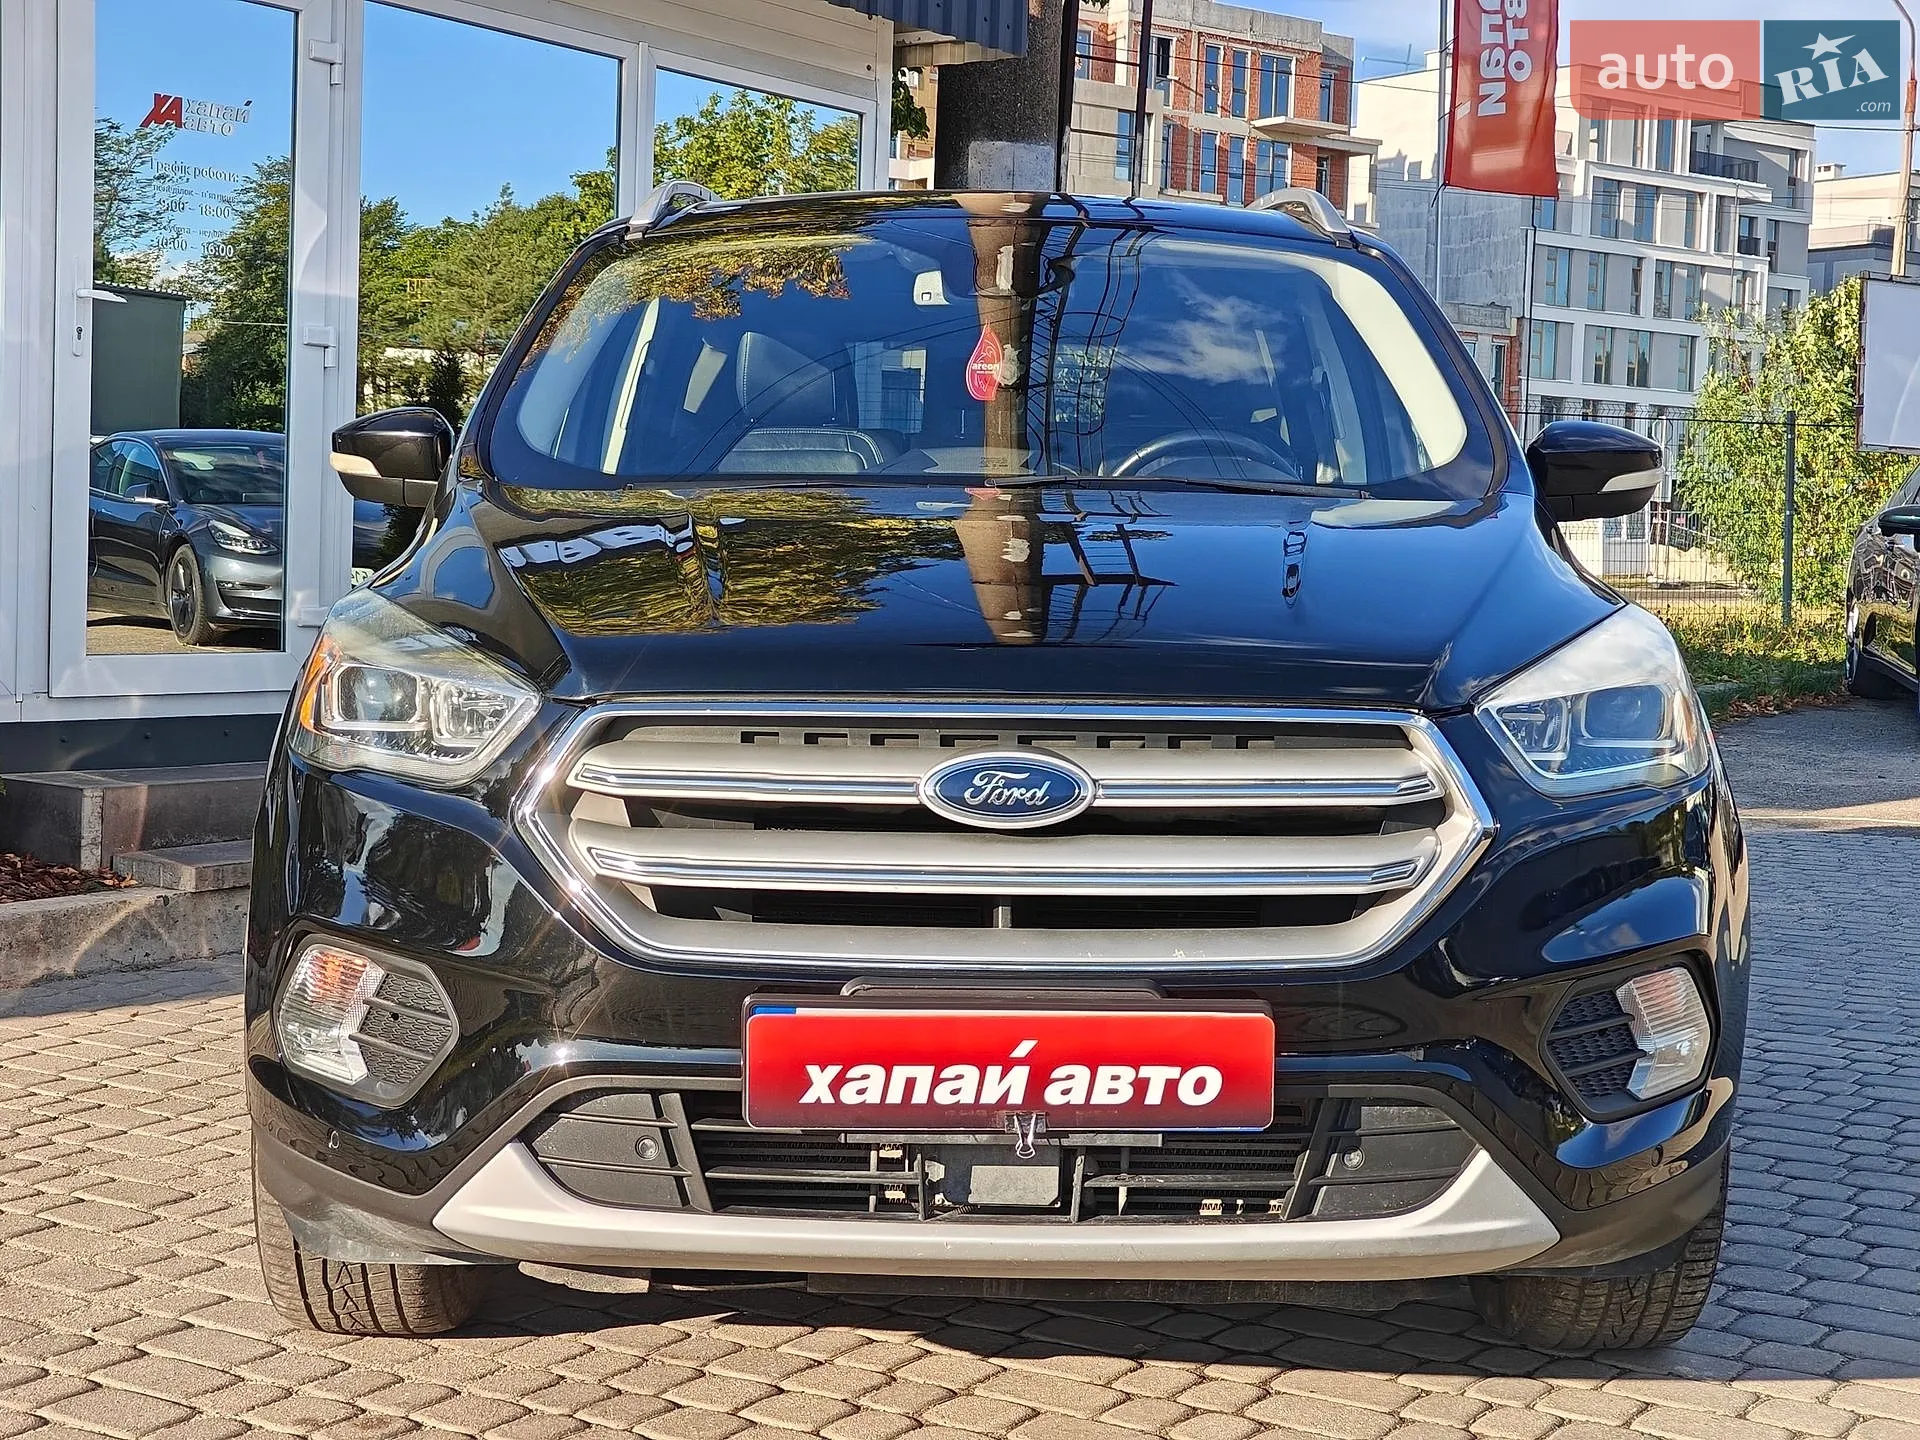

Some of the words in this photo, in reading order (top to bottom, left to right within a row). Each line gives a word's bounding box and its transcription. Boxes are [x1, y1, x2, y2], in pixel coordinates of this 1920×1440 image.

[199, 203, 231, 219] 18:00
[201, 240, 234, 258] 16:00
[963, 769, 1051, 806] Ford
[799, 1039, 1038, 1106] хапай
[1043, 1063, 1223, 1107] авто
